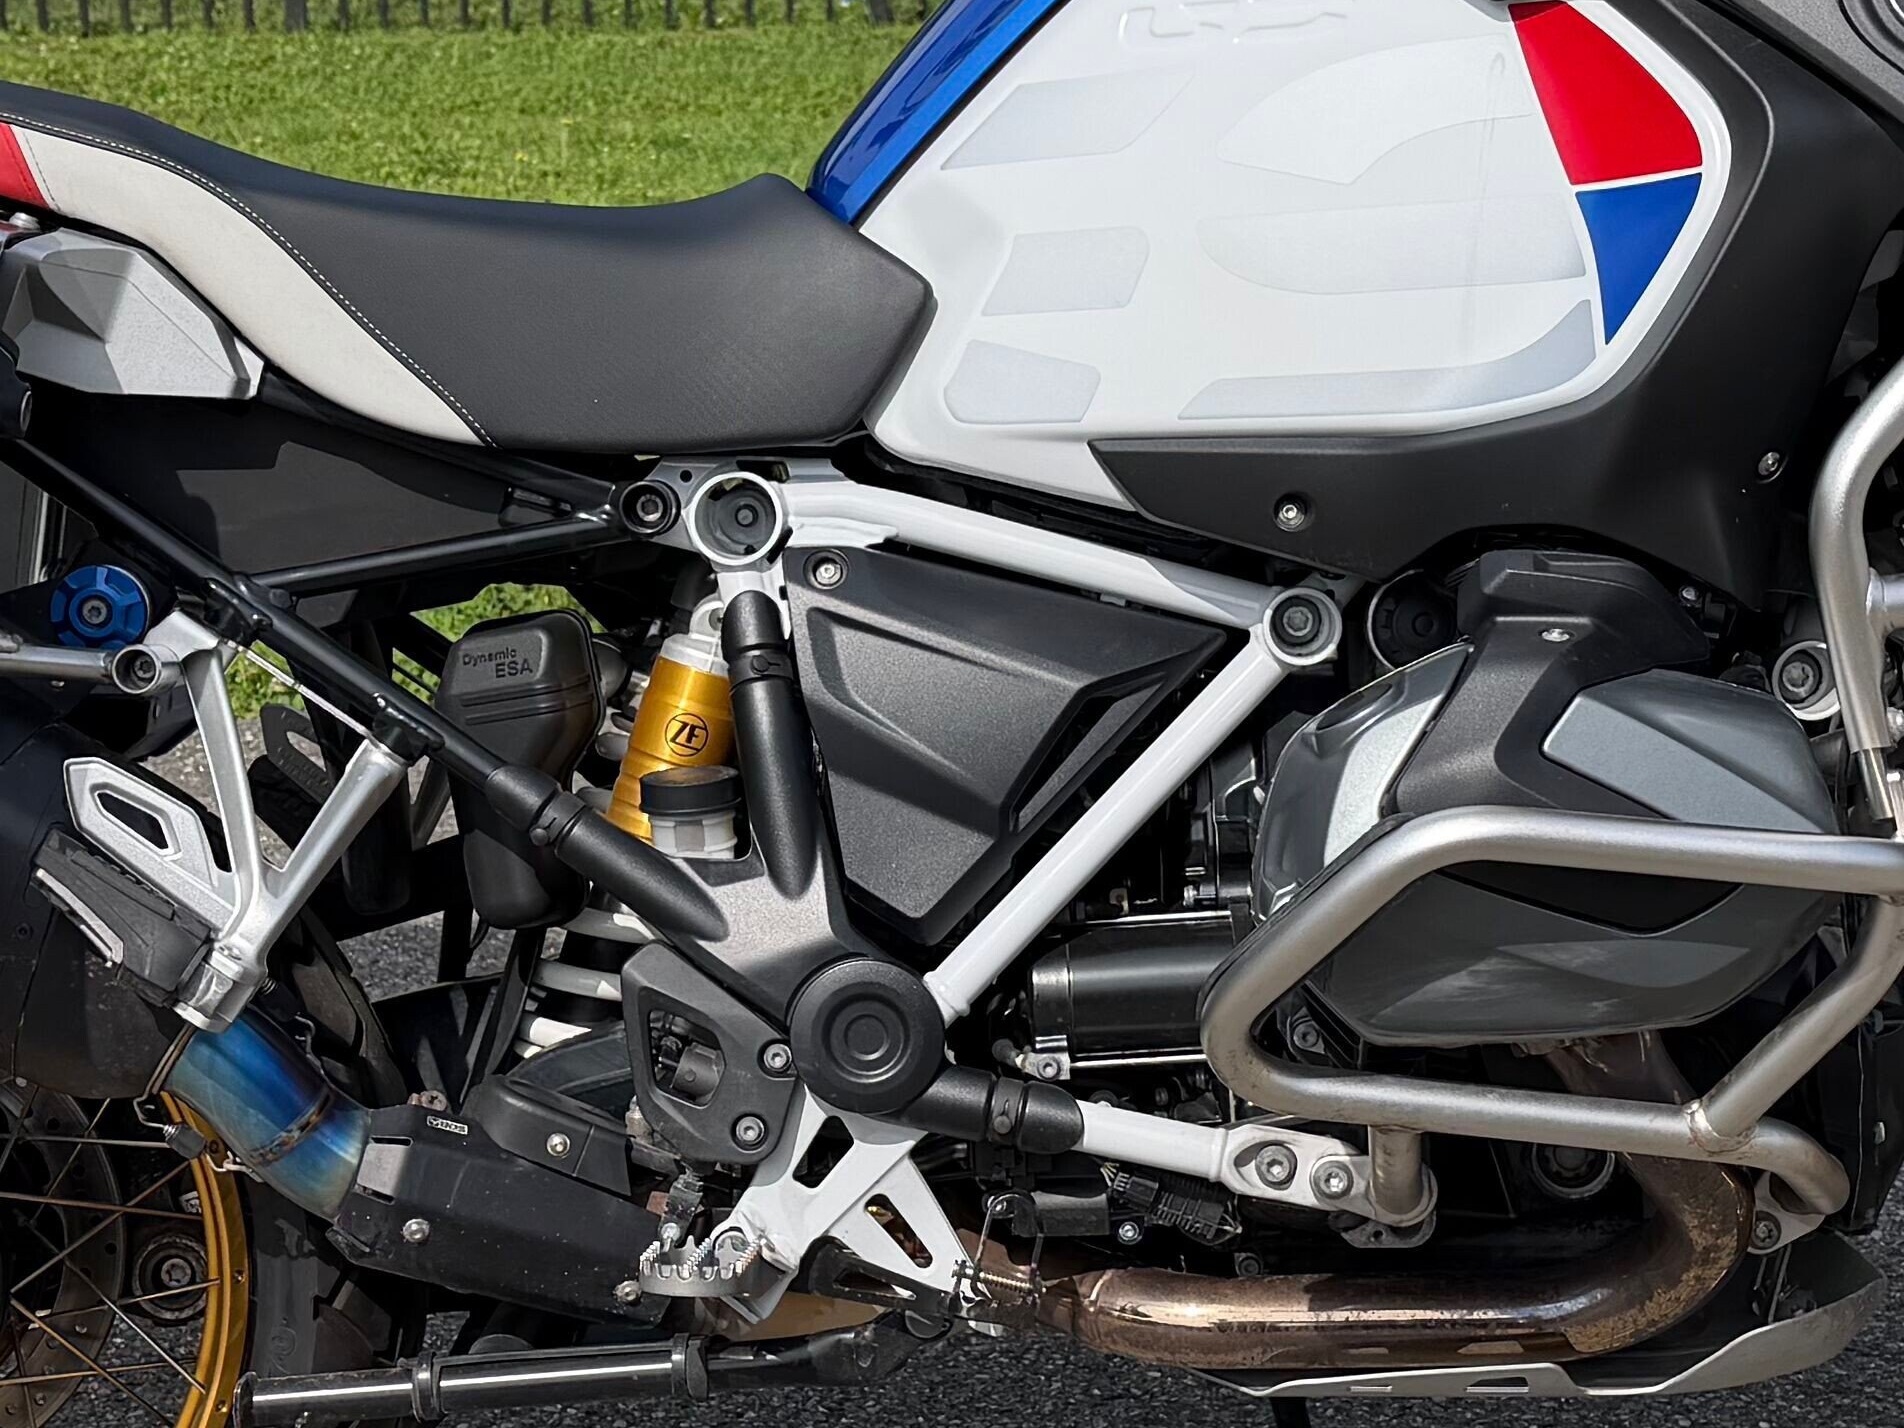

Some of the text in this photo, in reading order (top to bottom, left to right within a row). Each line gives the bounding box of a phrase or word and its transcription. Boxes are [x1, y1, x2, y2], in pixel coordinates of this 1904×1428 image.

[463, 647, 517, 667] Dynamic
[495, 658, 533, 678] ESA
[670, 718, 707, 751] ZF
